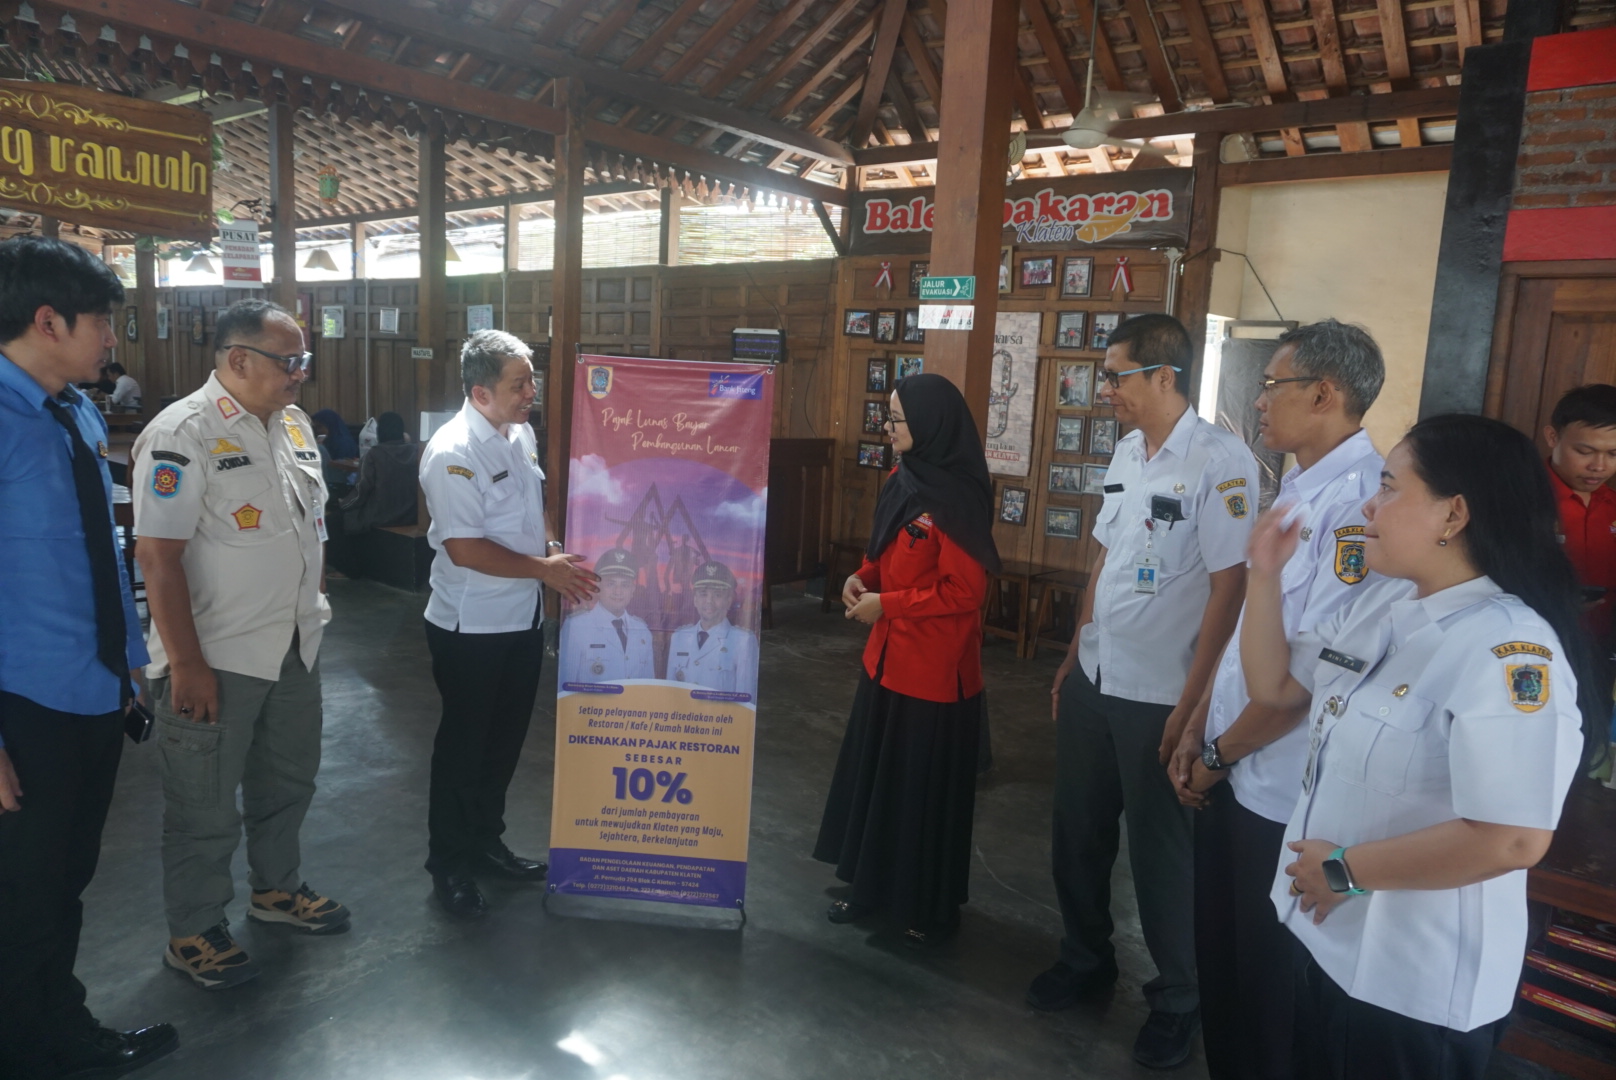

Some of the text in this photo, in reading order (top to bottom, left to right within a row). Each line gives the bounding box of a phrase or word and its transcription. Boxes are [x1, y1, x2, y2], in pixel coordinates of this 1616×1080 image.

[50, 135, 207, 196] rawuh
[222, 230, 257, 242] PUSAT
[1016, 216, 1073, 242] Klaten
[602, 408, 710, 435] Pajak Lunas Bayar
[632, 431, 741, 454] Pembangunan Lancar
[1219, 480, 1244, 490] KLATEN
[1520, 644, 1550, 658] KLATEN
[579, 706, 733, 724] Setiap pelayanan yang disediakan oleh
[588, 719, 624, 730] Restoran
[630, 721, 648, 731] Kafe
[654, 722, 682, 733] Rumah
[684, 724, 710, 735] Makan
[712, 726, 722, 736] ini
[568, 735, 740, 755] DIKENAKAN PAJAK RESTORAN
[625, 753, 682, 765] SEBESAR
[612, 766, 693, 805] 10%
[601, 806, 700, 821] dari jumlah pembayaran
[575, 818, 724, 837] untuk mewujudkan Klaten yang Maju,
[599, 832, 698, 847] Sejahtera, Berkelanjutan
[601, 858, 641, 866] PENGELOLAAN
[676, 864, 715, 872] PENDAPATAN
[644, 869, 679, 877] KABUPATEN
